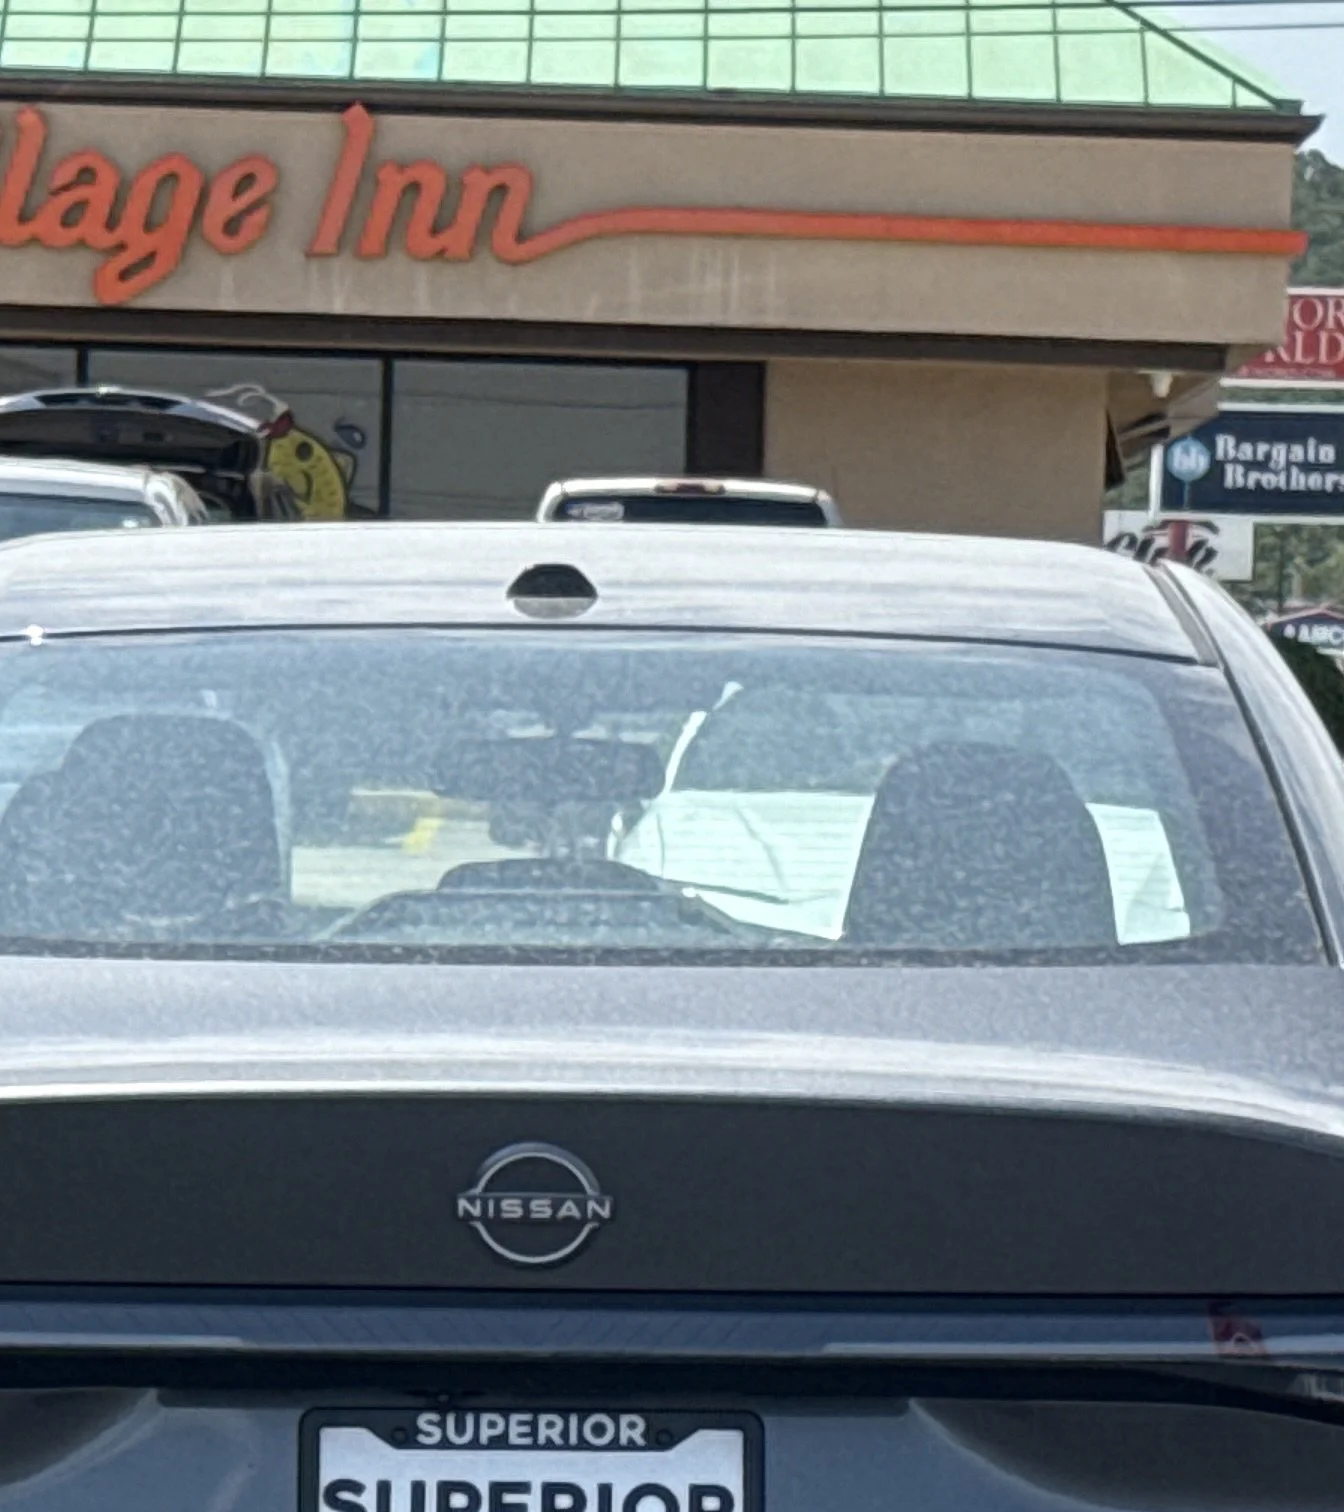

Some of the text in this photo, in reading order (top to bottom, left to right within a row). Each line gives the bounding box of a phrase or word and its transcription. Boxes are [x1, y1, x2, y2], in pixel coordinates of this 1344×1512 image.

[305, 102, 534, 263] Inn
[1214, 433, 1336, 471] Bargain
[457, 1197, 611, 1220] NISSAN
[415, 1411, 648, 1447] SUPERIOR
